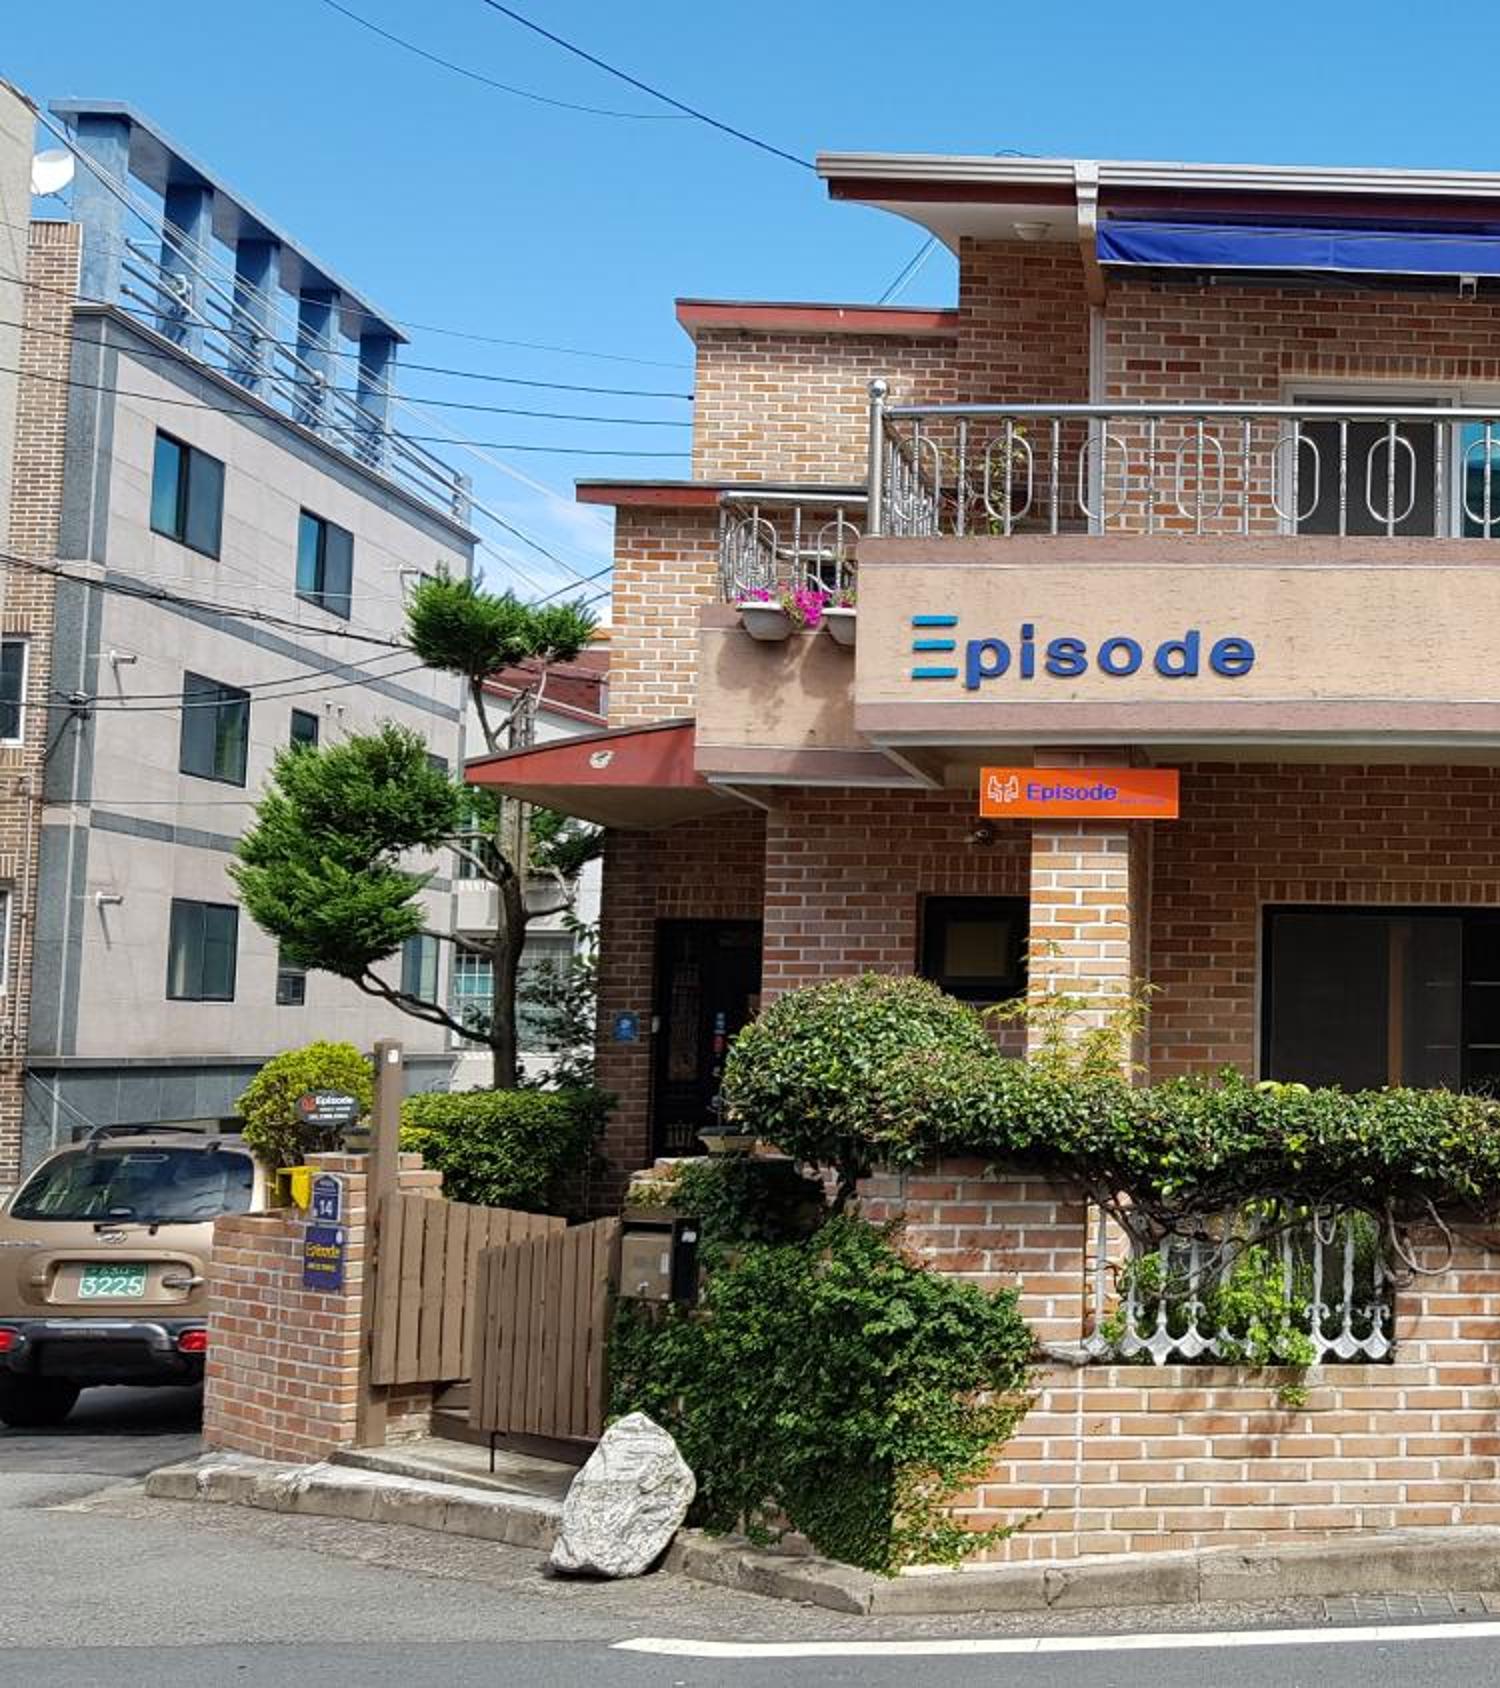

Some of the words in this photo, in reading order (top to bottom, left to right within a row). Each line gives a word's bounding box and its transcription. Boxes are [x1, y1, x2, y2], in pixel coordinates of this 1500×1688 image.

[911, 615, 1255, 690] Episode
[1025, 783, 1118, 801] Episode
[81, 1276, 142, 1297] 3225
